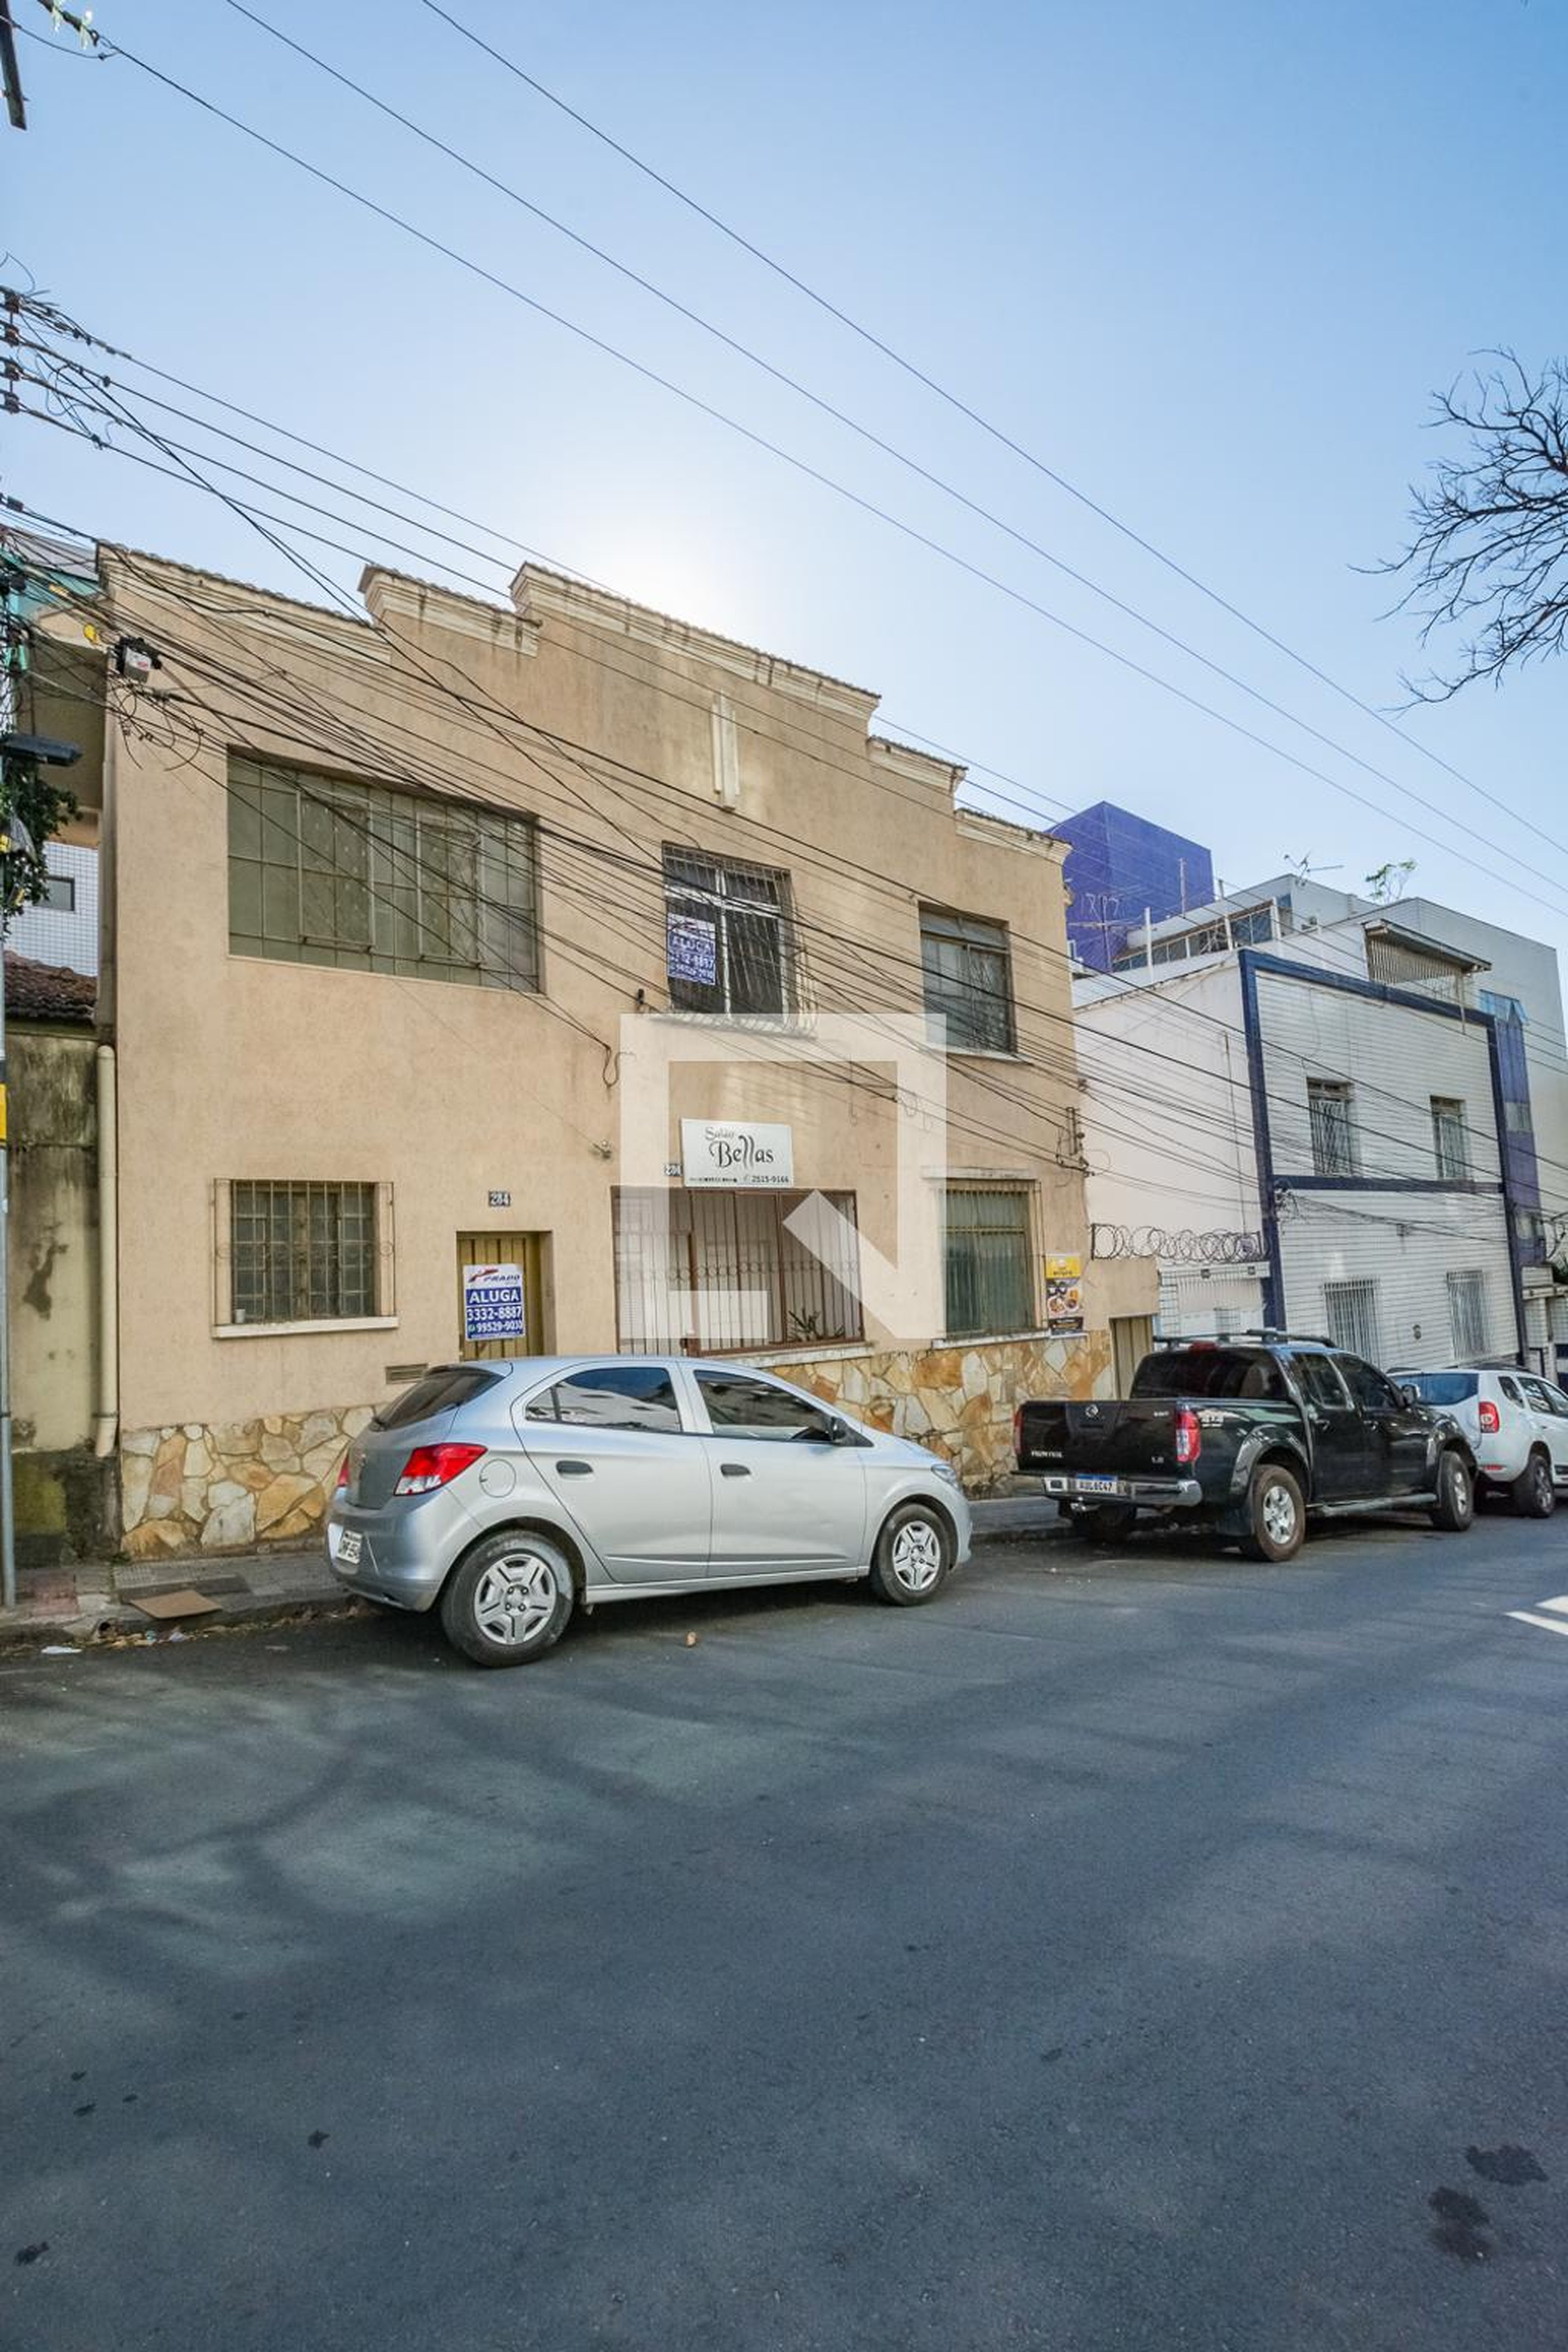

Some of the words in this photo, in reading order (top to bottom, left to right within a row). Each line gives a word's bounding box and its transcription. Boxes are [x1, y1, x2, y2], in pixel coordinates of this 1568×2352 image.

[709, 1135, 774, 1169] Bellas
[490, 1192, 510, 1205] 284
[470, 1289, 519, 1303] ALUGA
[467, 1306, 521, 1321] 3332-8887
